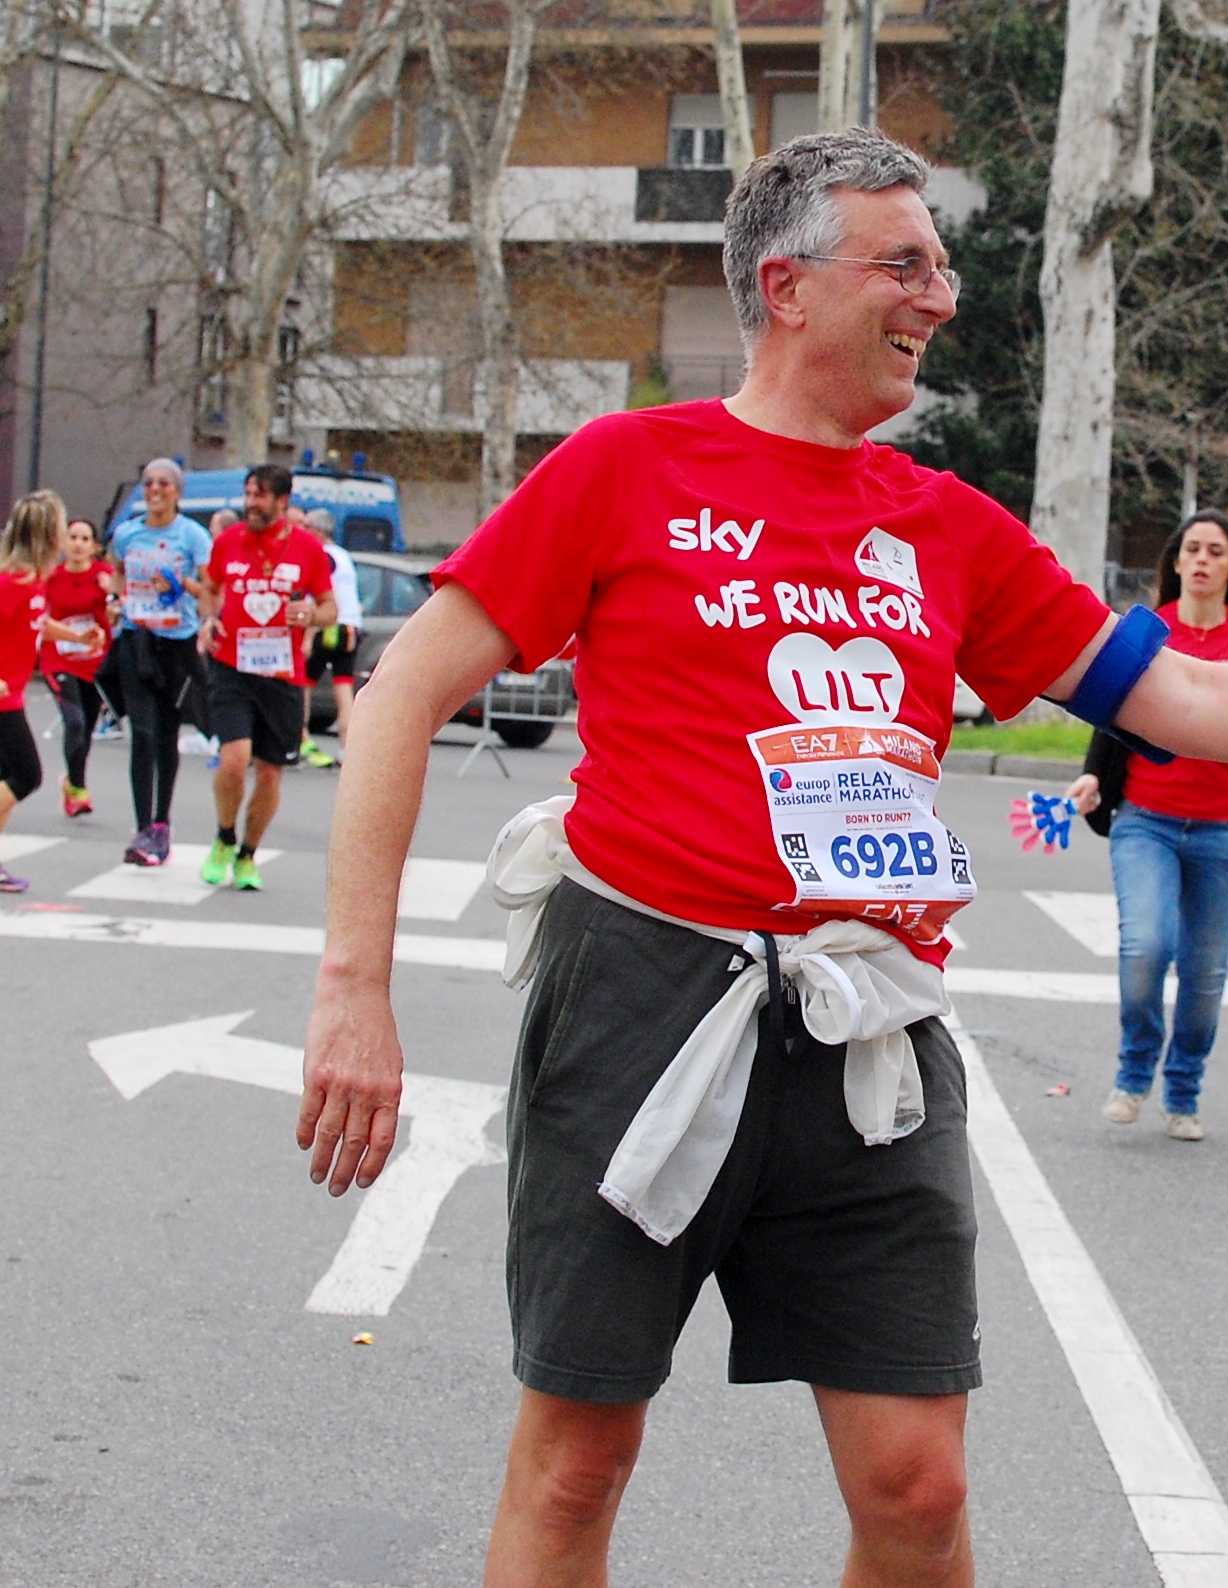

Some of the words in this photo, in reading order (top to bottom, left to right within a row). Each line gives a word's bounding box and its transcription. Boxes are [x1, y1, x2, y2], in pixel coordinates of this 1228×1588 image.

[668, 508, 765, 560] sky
[694, 580, 766, 629] WE
[773, 581, 857, 628] RUN
[858, 585, 930, 638] FOR
[791, 669, 893, 712] LILT
[790, 733, 838, 753] EA7
[881, 735, 923, 756] MILANO
[774, 792, 833, 806] assistance
[839, 786, 914, 802] MARATHO
[795, 779, 831, 792] europ
[837, 771, 893, 788] RELAY
[845, 814, 870, 825] BORN
[871, 813, 883, 823] TO
[884, 812, 911, 823] RUN??
[830, 831, 938, 879] 692B
